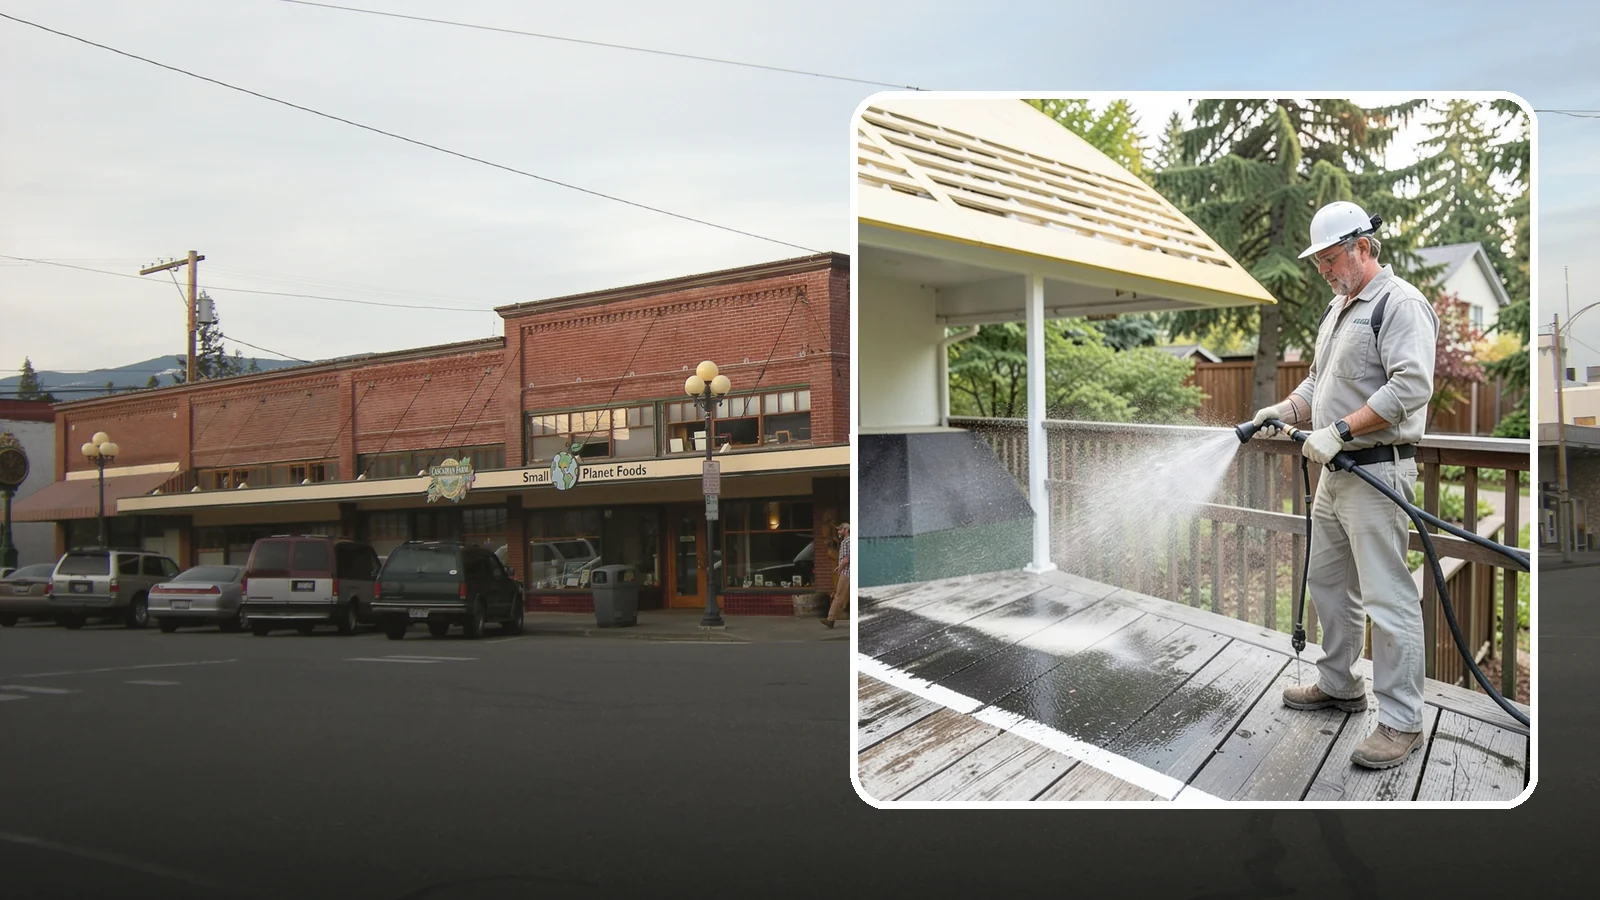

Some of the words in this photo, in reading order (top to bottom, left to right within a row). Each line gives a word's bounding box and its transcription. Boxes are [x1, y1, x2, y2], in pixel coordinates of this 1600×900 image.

[523, 471, 549, 483] Small
[582, 467, 614, 479] Planet
[616, 464, 647, 477] Foods
